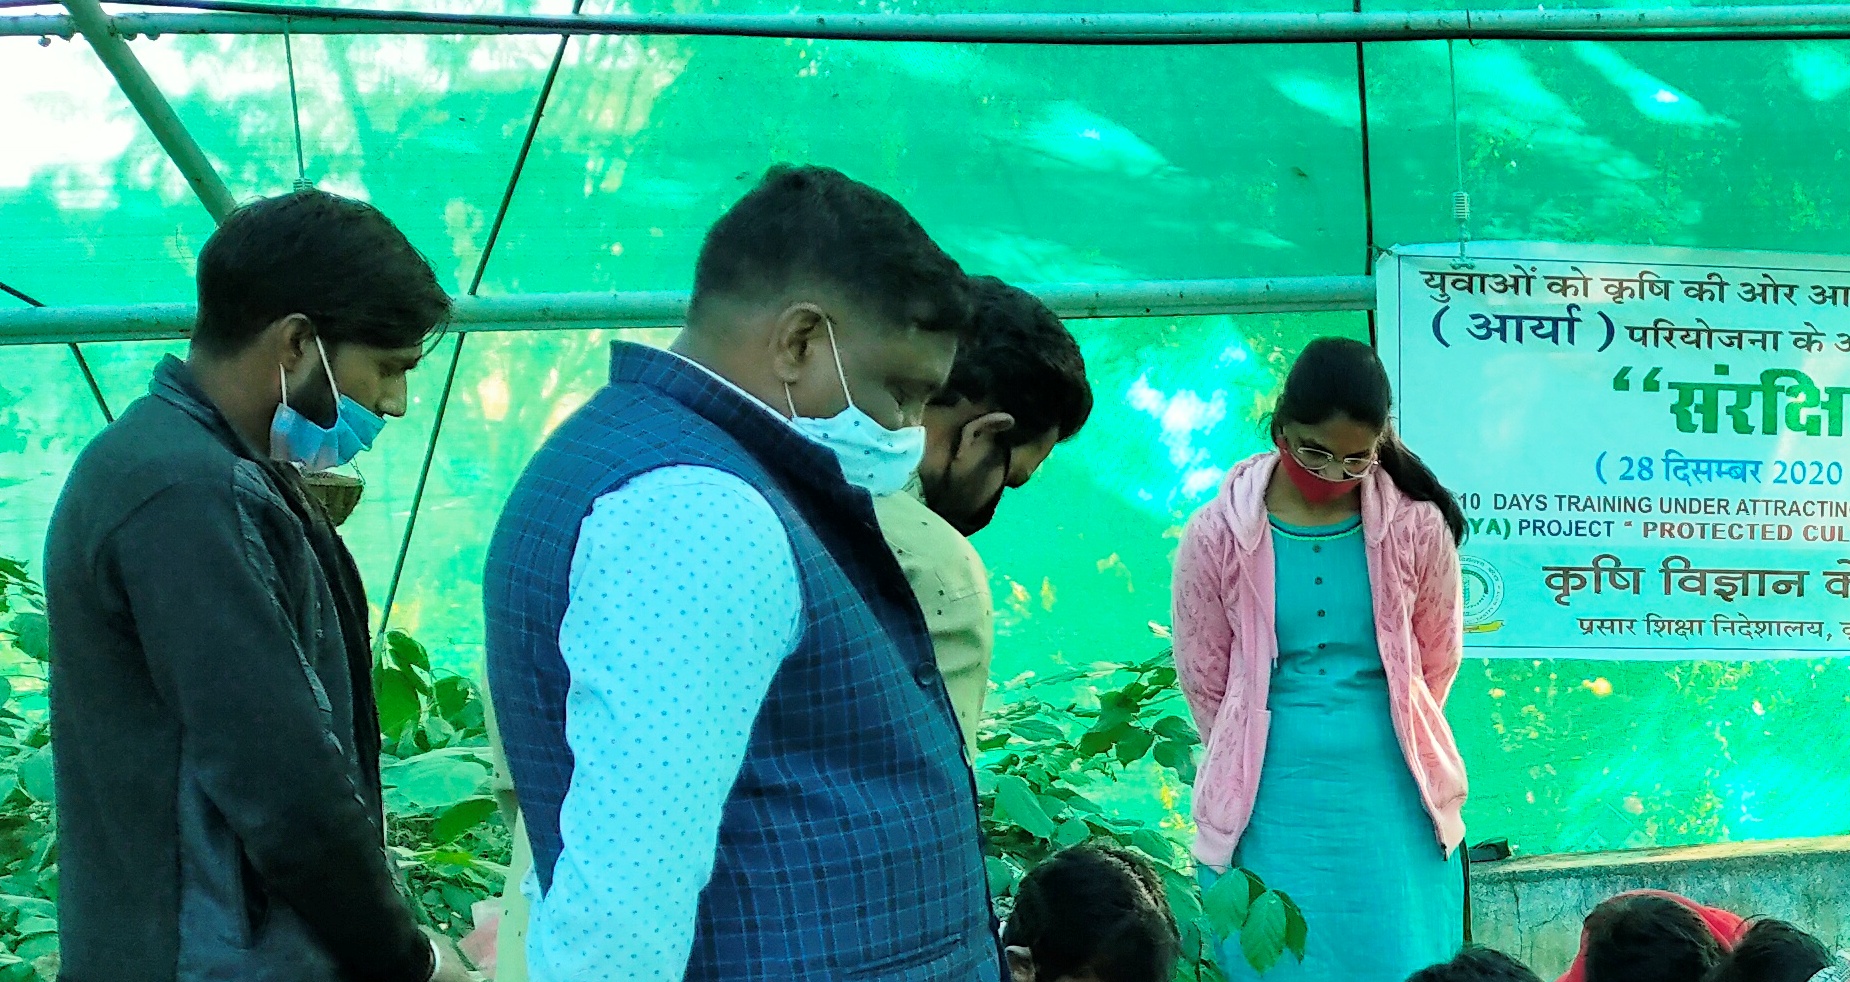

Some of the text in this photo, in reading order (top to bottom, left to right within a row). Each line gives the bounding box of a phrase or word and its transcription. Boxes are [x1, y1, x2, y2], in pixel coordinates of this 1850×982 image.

[1419, 265, 1537, 303] युवाओं
[1542, 266, 1593, 299] को
[1600, 270, 1674, 304] कृषि
[1680, 273, 1730, 302] की
[1736, 273, 1799, 306] ओर
[1467, 303, 1582, 346] आर्या
[1624, 317, 1783, 352] परियोजना
[1789, 321, 1826, 353] के
[1618, 455, 1654, 483] 28
[1662, 449, 1764, 485] दिसम्बर
[1772, 459, 1844, 486] 2020
[1460, 492, 1481, 511] 10
[1494, 493, 1548, 512] DAYS
[1554, 494, 1653, 514] TRAINING
[1659, 497, 1731, 516] UNDER
[1468, 517, 1511, 540] YA)
[1518, 519, 1616, 538] PROJECT
[1642, 521, 1794, 542] PROTECTED
[1541, 553, 1647, 607] कृषि
[1658, 555, 1811, 604] विज्ञान
[1576, 616, 1637, 637] प्रसार
[1644, 612, 1706, 639] शिक्षा
[1709, 612, 1833, 642] निदेशालय,
